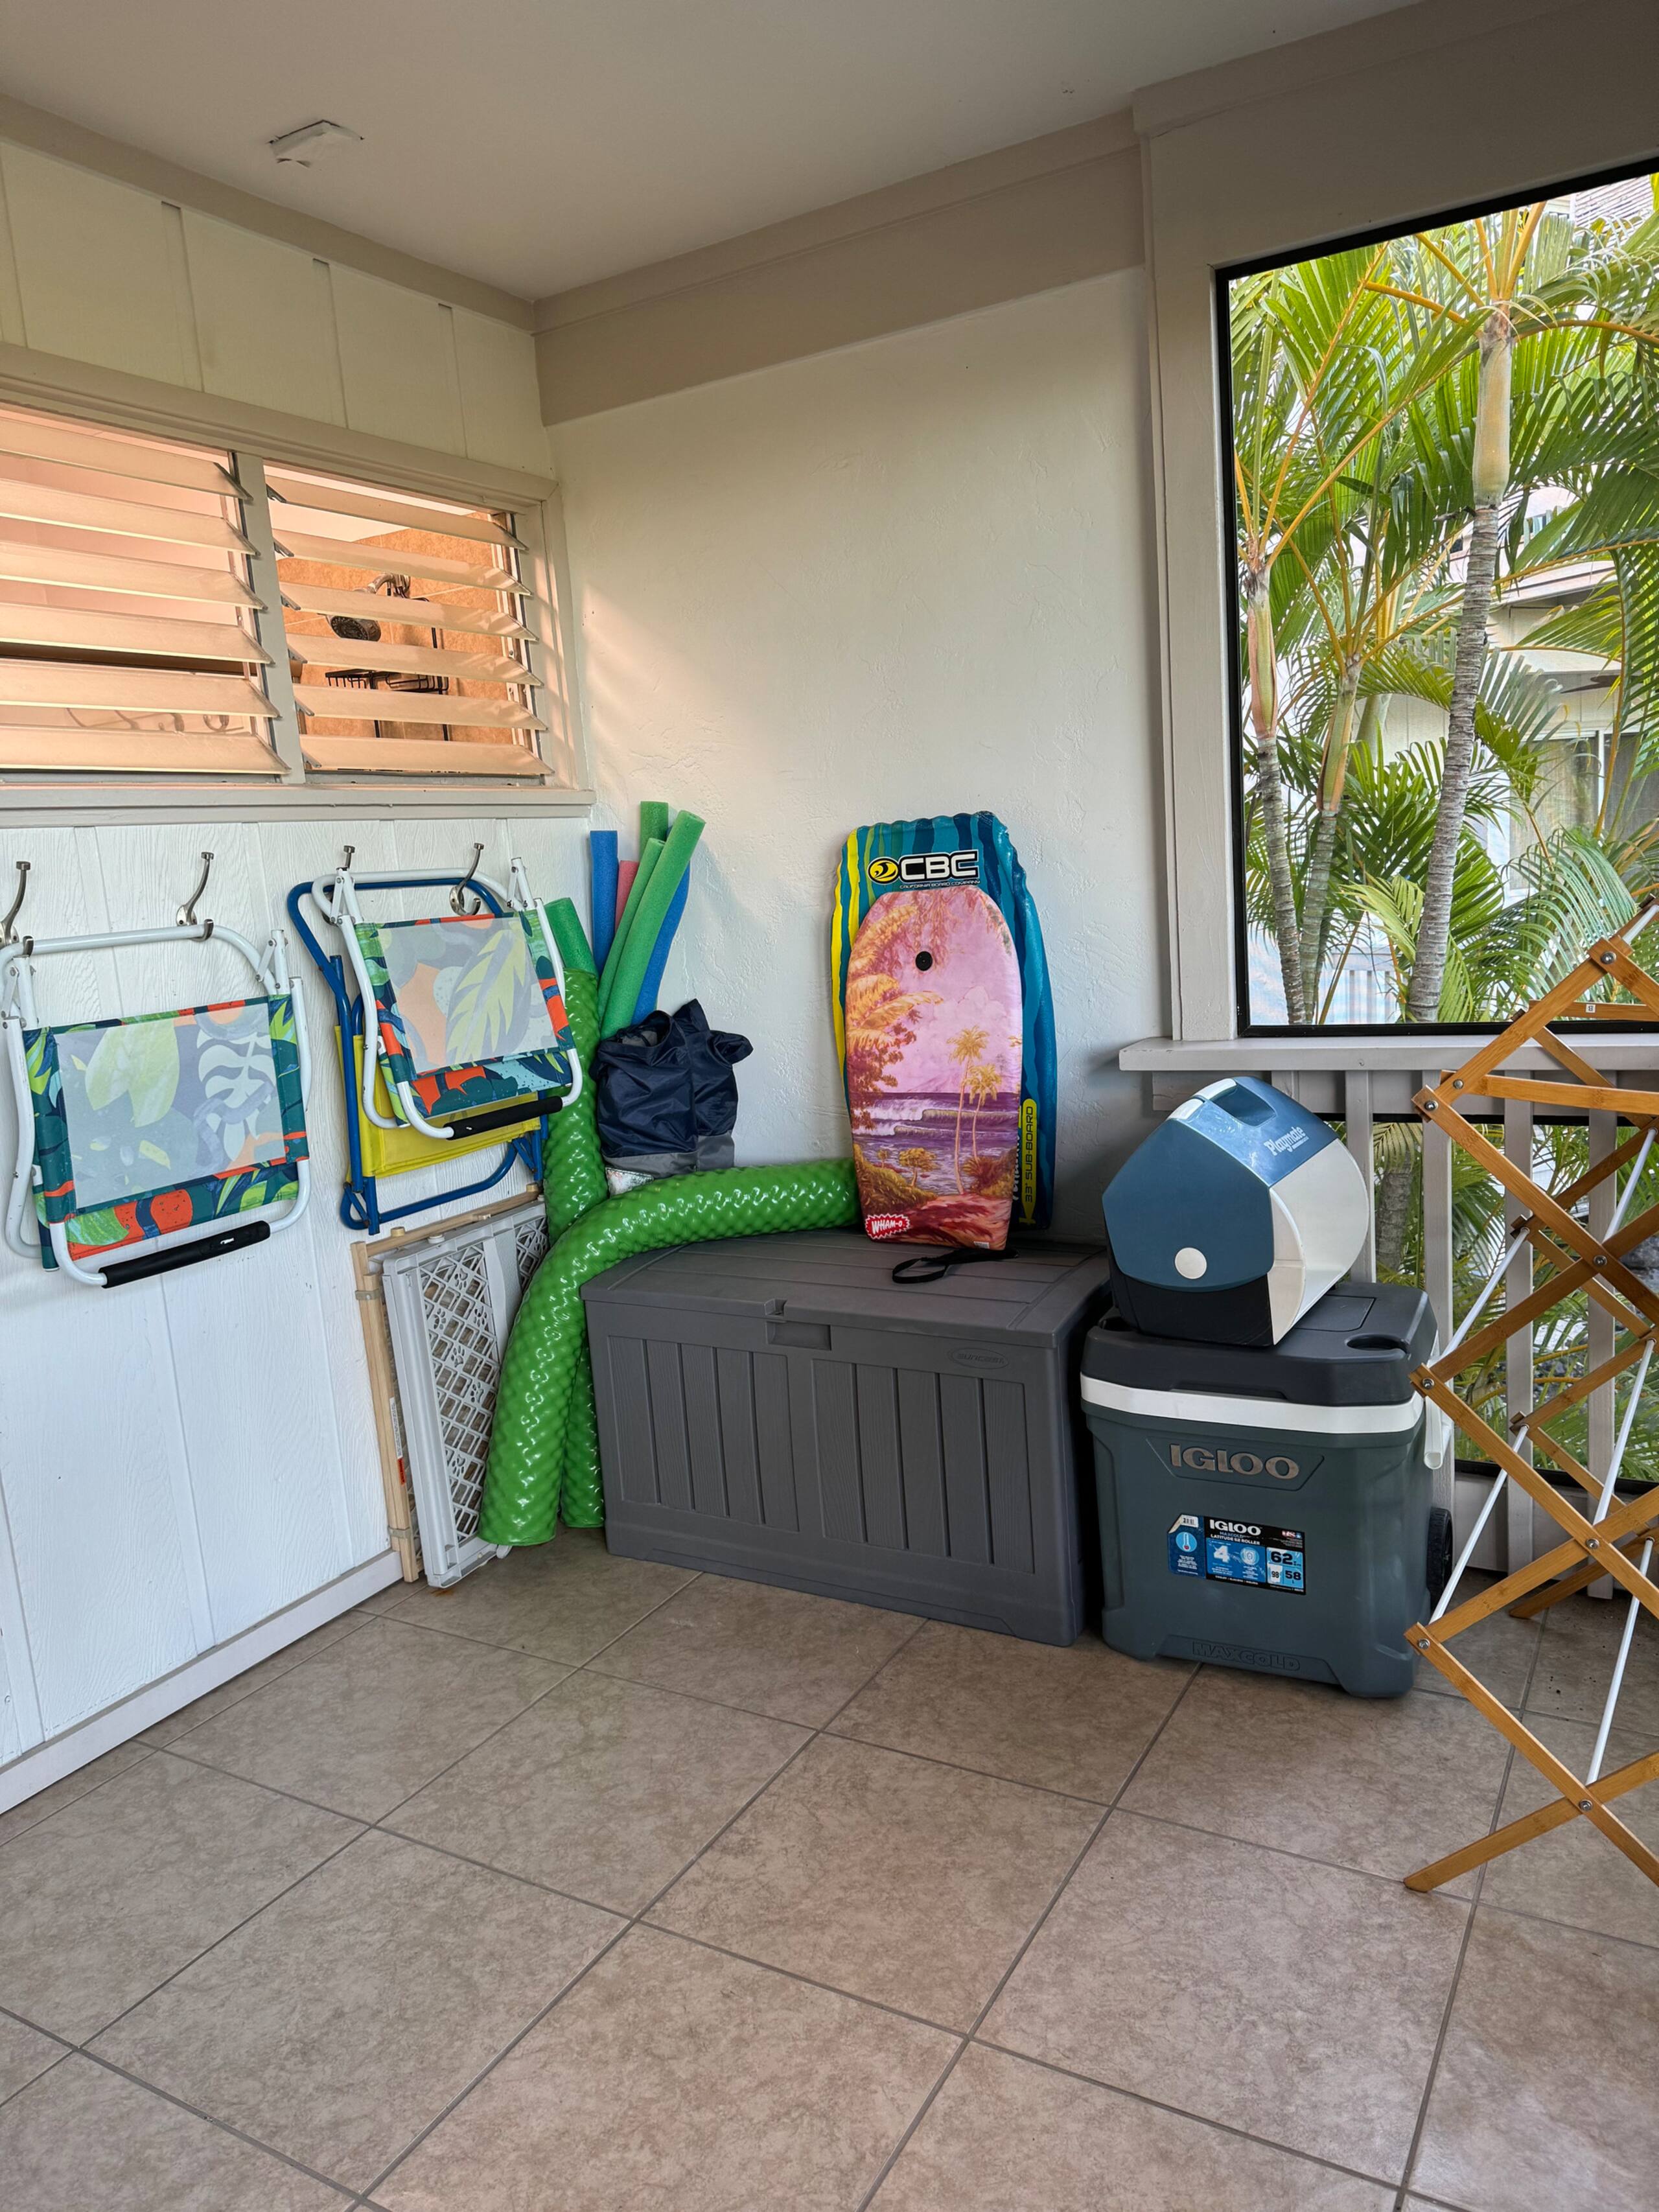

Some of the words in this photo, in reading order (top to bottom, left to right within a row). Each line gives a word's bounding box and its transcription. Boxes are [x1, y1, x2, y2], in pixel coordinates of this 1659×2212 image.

[901, 853, 976, 881] CBC
[1264, 1126, 1306, 1156] Playmate
[872, 1220, 903, 1235] WHAM-O
[1170, 1444, 1299, 1480] IGLOO
[1209, 1519, 1261, 1536] IGLOO
[1214, 1545, 1229, 1563] 4
[1271, 1551, 1293, 1565] 62
[1285, 1570, 1301, 1581] 58
[1192, 1641, 1300, 1671] MAXCOLD
